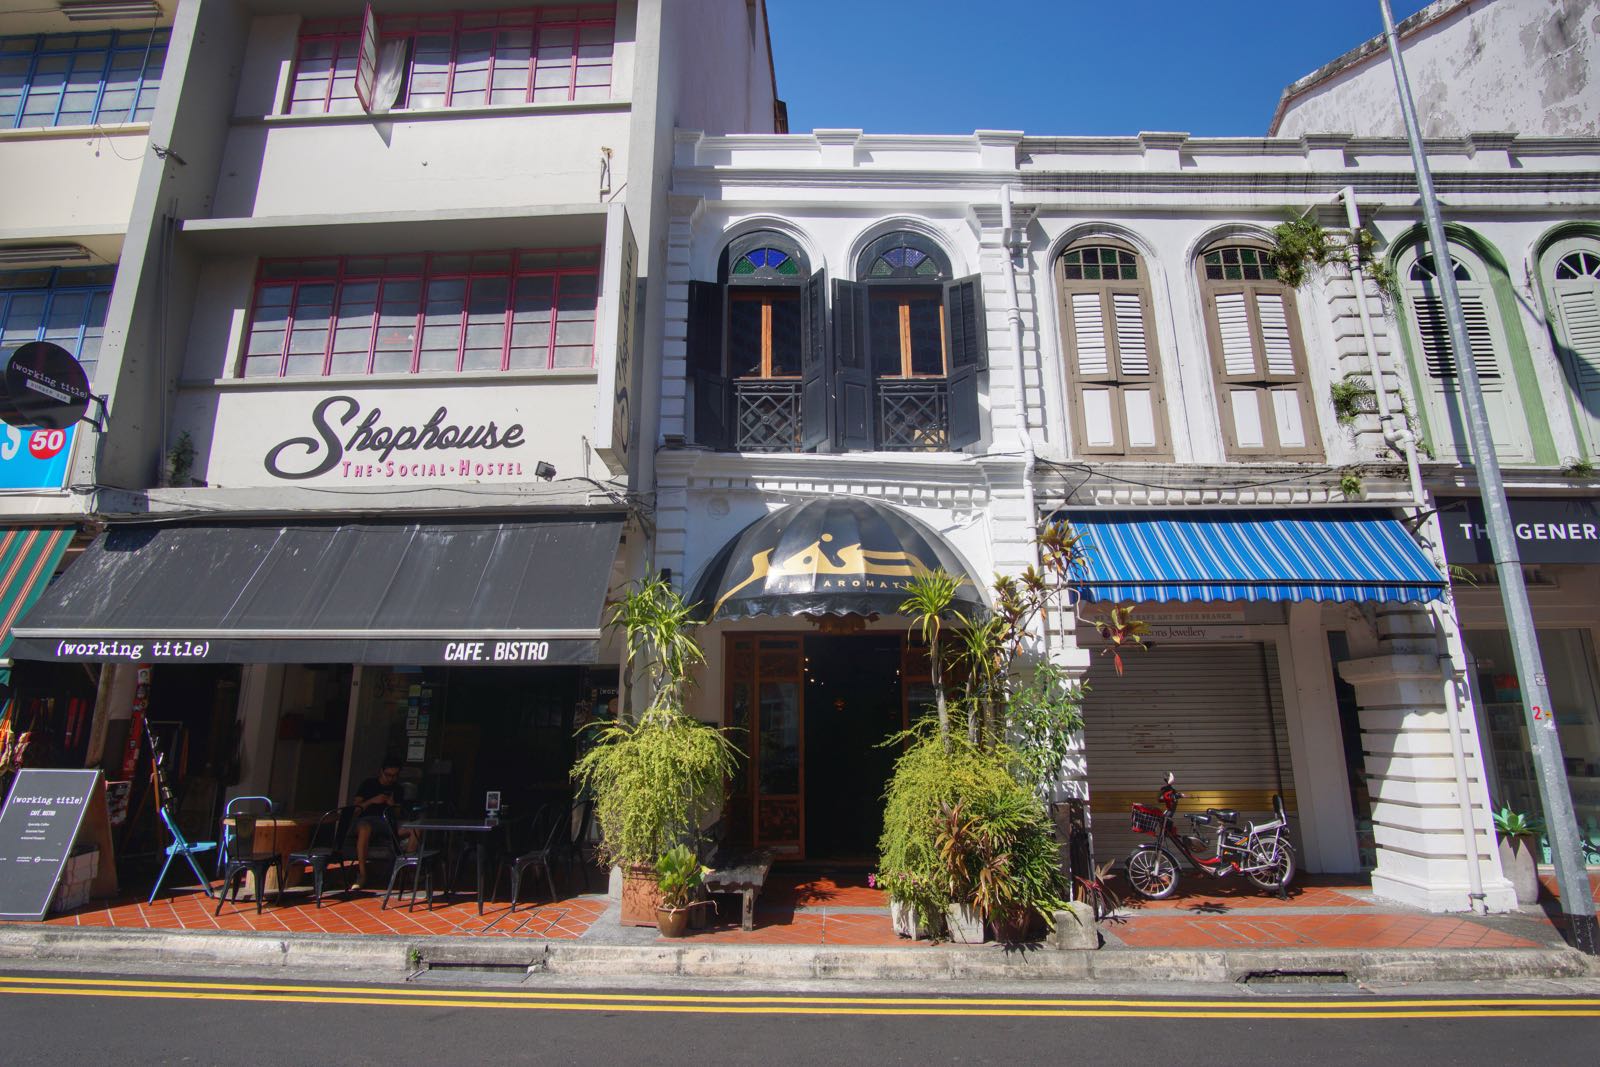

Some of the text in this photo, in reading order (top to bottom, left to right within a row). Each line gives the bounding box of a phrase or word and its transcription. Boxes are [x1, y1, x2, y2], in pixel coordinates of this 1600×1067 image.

[31, 430, 64, 451] 50
[264, 395, 525, 480] Shophouse
[458, 459, 523, 476] HOSTEL
[1459, 523, 1600, 540] TH GENER
[1169, 627, 1206, 639] Jewellery
[56, 640, 210, 660] (working title)
[444, 642, 484, 661] CAFE
[494, 641, 549, 660] BISTRO
[1532, 706, 1542, 721] 2
[12, 795, 83, 806] (working title)
